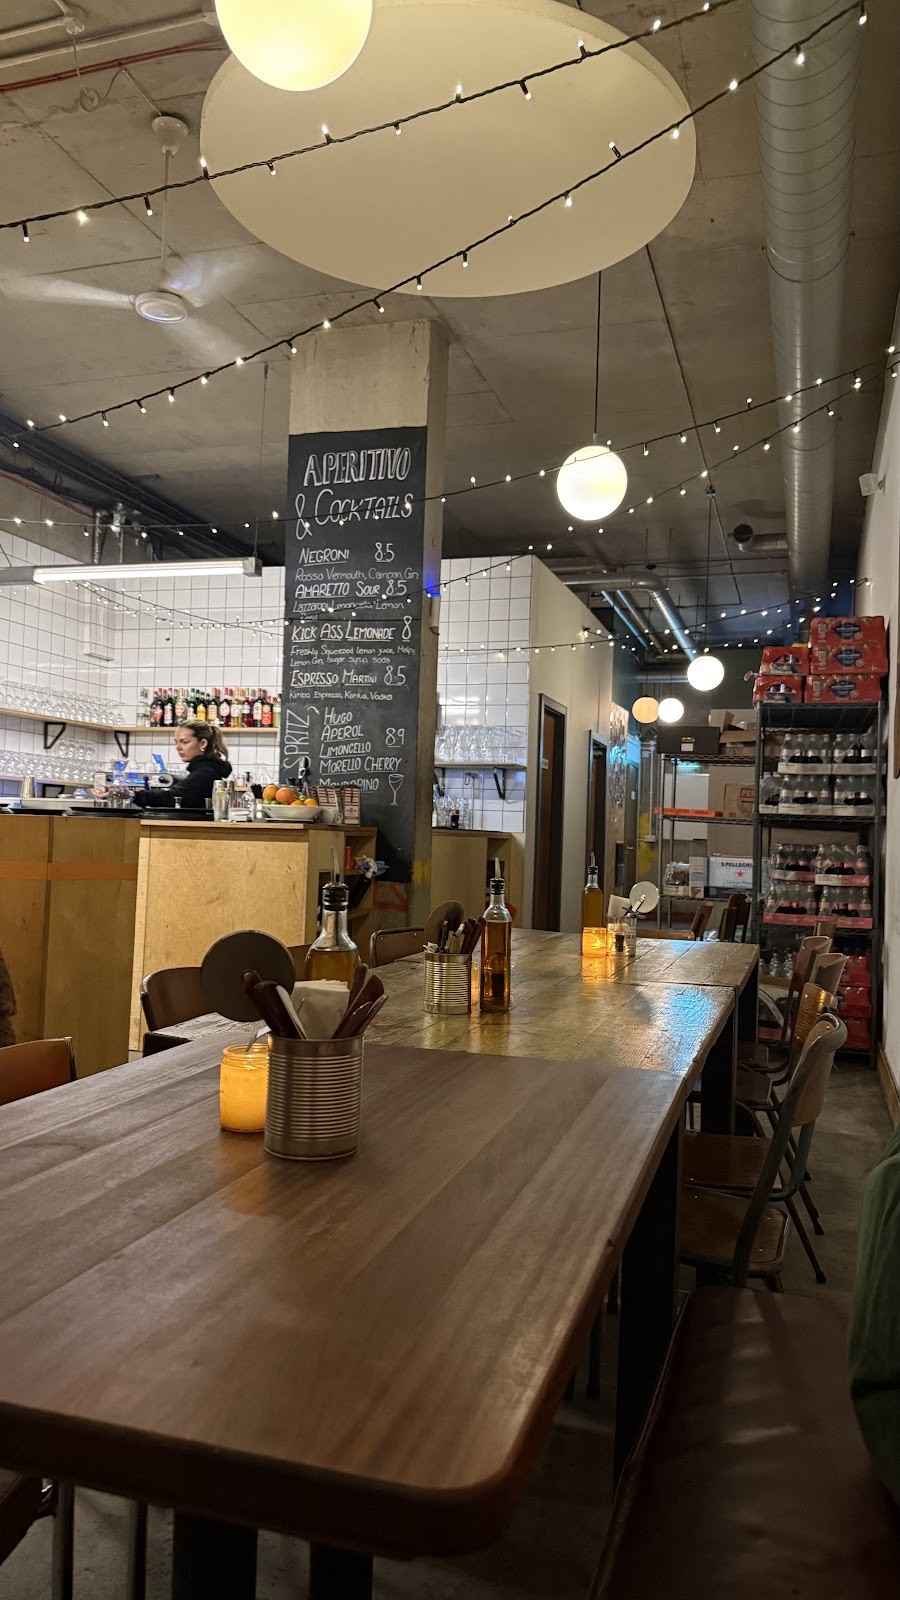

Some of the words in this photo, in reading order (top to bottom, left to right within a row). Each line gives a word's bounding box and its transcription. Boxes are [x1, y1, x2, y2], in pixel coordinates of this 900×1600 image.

[303, 448, 412, 487] APERITIVO
[295, 493, 313, 540] &
[315, 488, 414, 525] COCKTAILS
[298, 547, 350, 565] NEGRONI
[374, 542, 395, 562] 8.5
[295, 567, 324, 582] Rosso
[404, 567, 419, 580] Gin
[295, 582, 350, 599] AMARETTO
[386, 579, 408, 597] 8.5
[291, 625, 317, 641] KICK
[320, 623, 343, 640] ASS
[345, 620, 396, 640] LEMONADE
[402, 615, 413, 641] 8
[290, 669, 339, 687] ESPRESSO
[341, 668, 378, 685] MARTINI
[323, 706, 353, 725] HUGO
[321, 725, 364, 741] APEROL
[320, 742, 372, 759] LIMONCELLO
[320, 758, 361, 773] MORELLO
[364, 756, 402, 772] CHERRY
